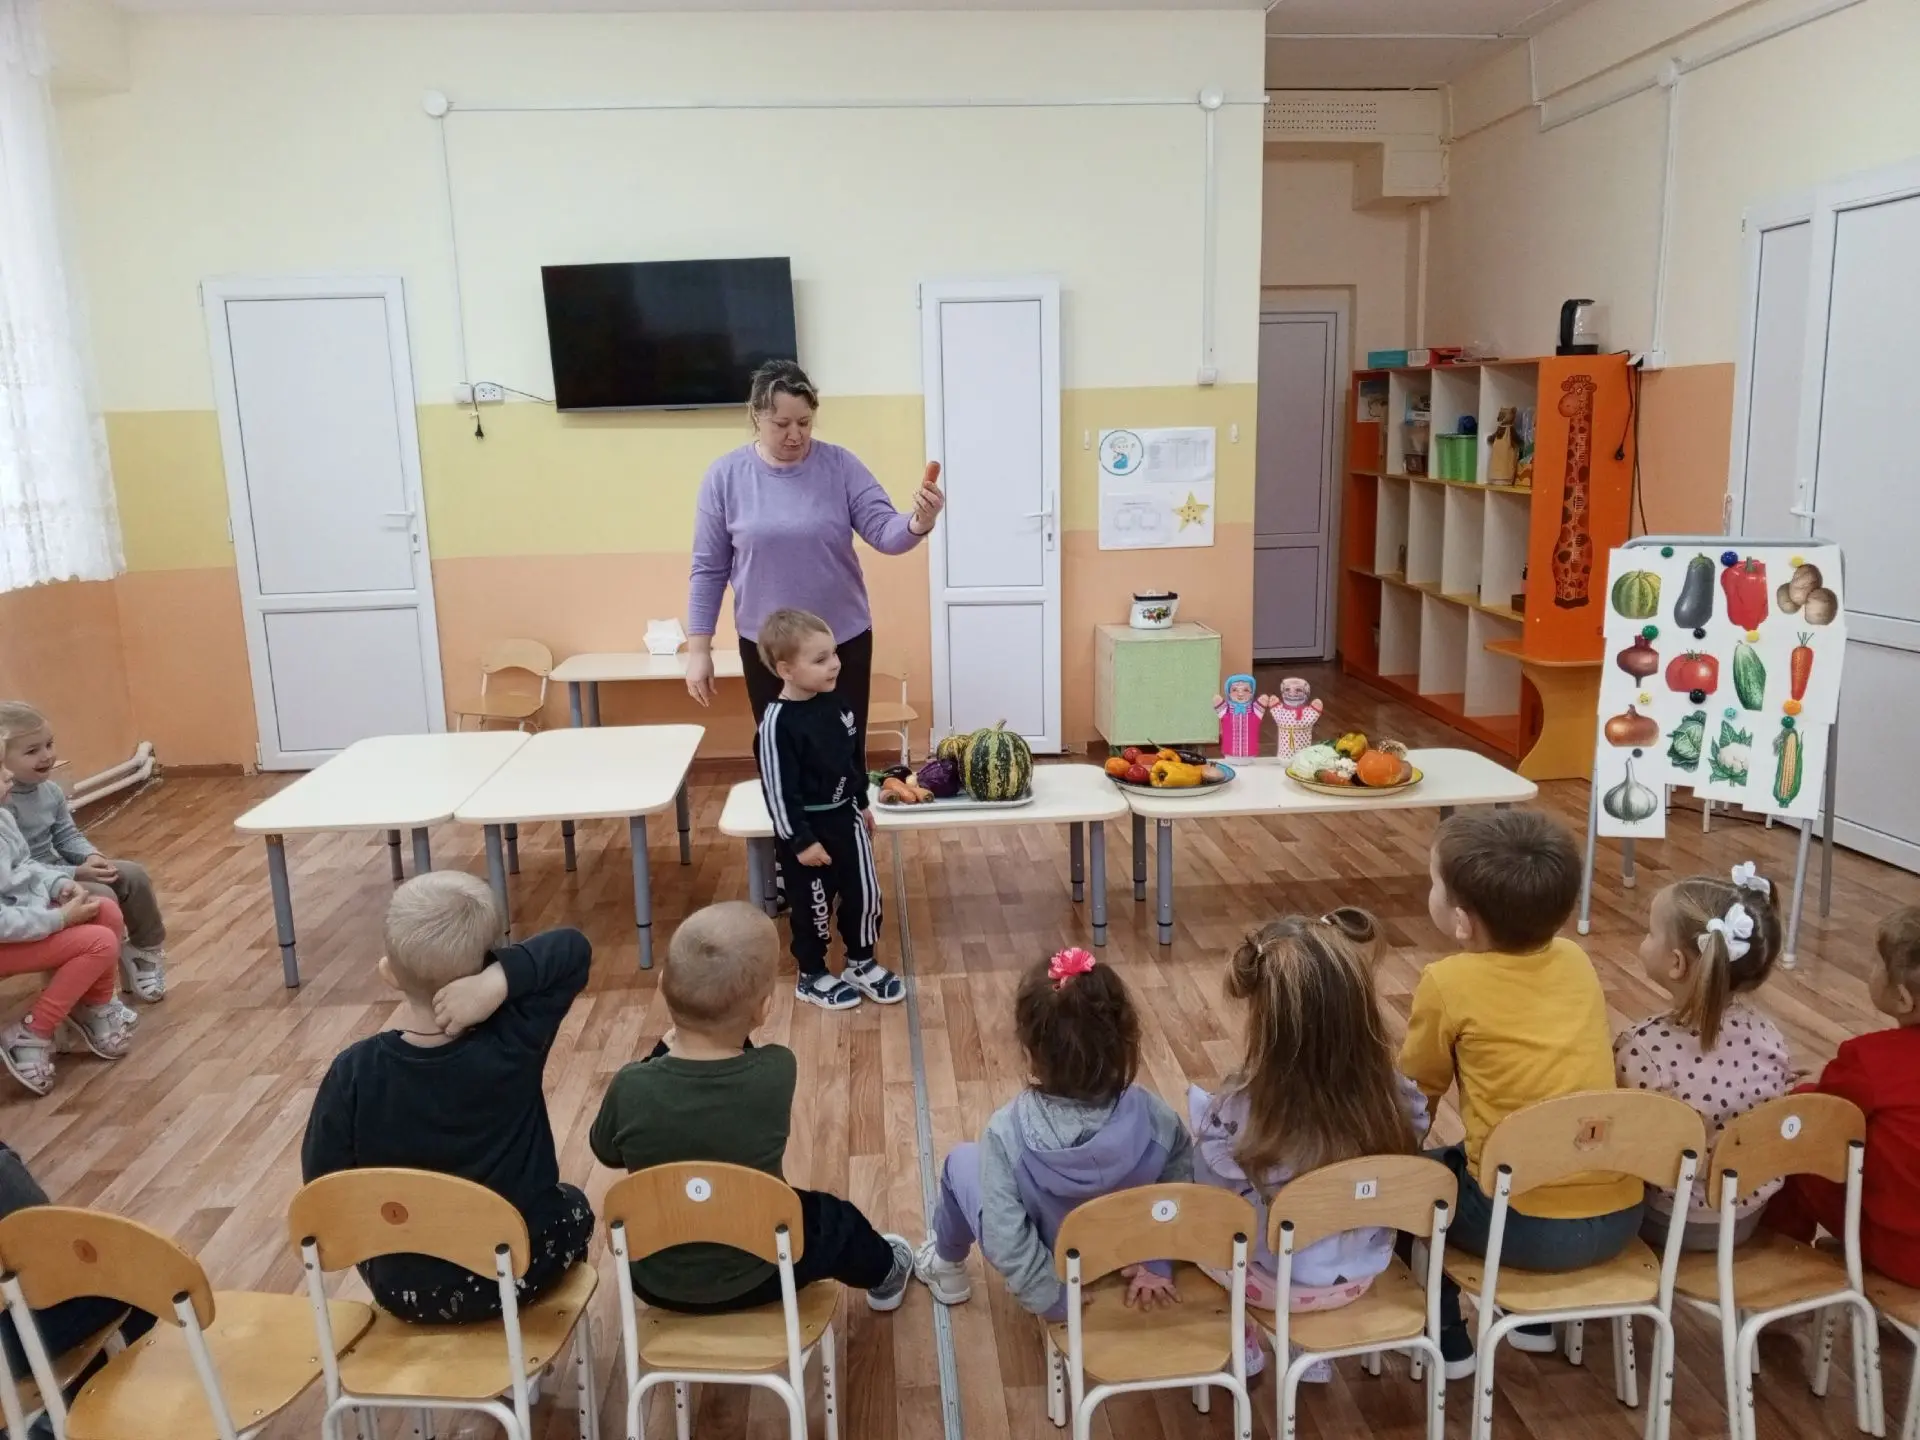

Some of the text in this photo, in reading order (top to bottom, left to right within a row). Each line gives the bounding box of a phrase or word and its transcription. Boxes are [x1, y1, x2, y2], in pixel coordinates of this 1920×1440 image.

[832, 776, 847, 803] didas
[811, 877, 830, 940] adidas
[1589, 1125, 1597, 1140] 1
[1361, 1183, 1371, 1196] 0
[1160, 1205, 1169, 1216] 0
